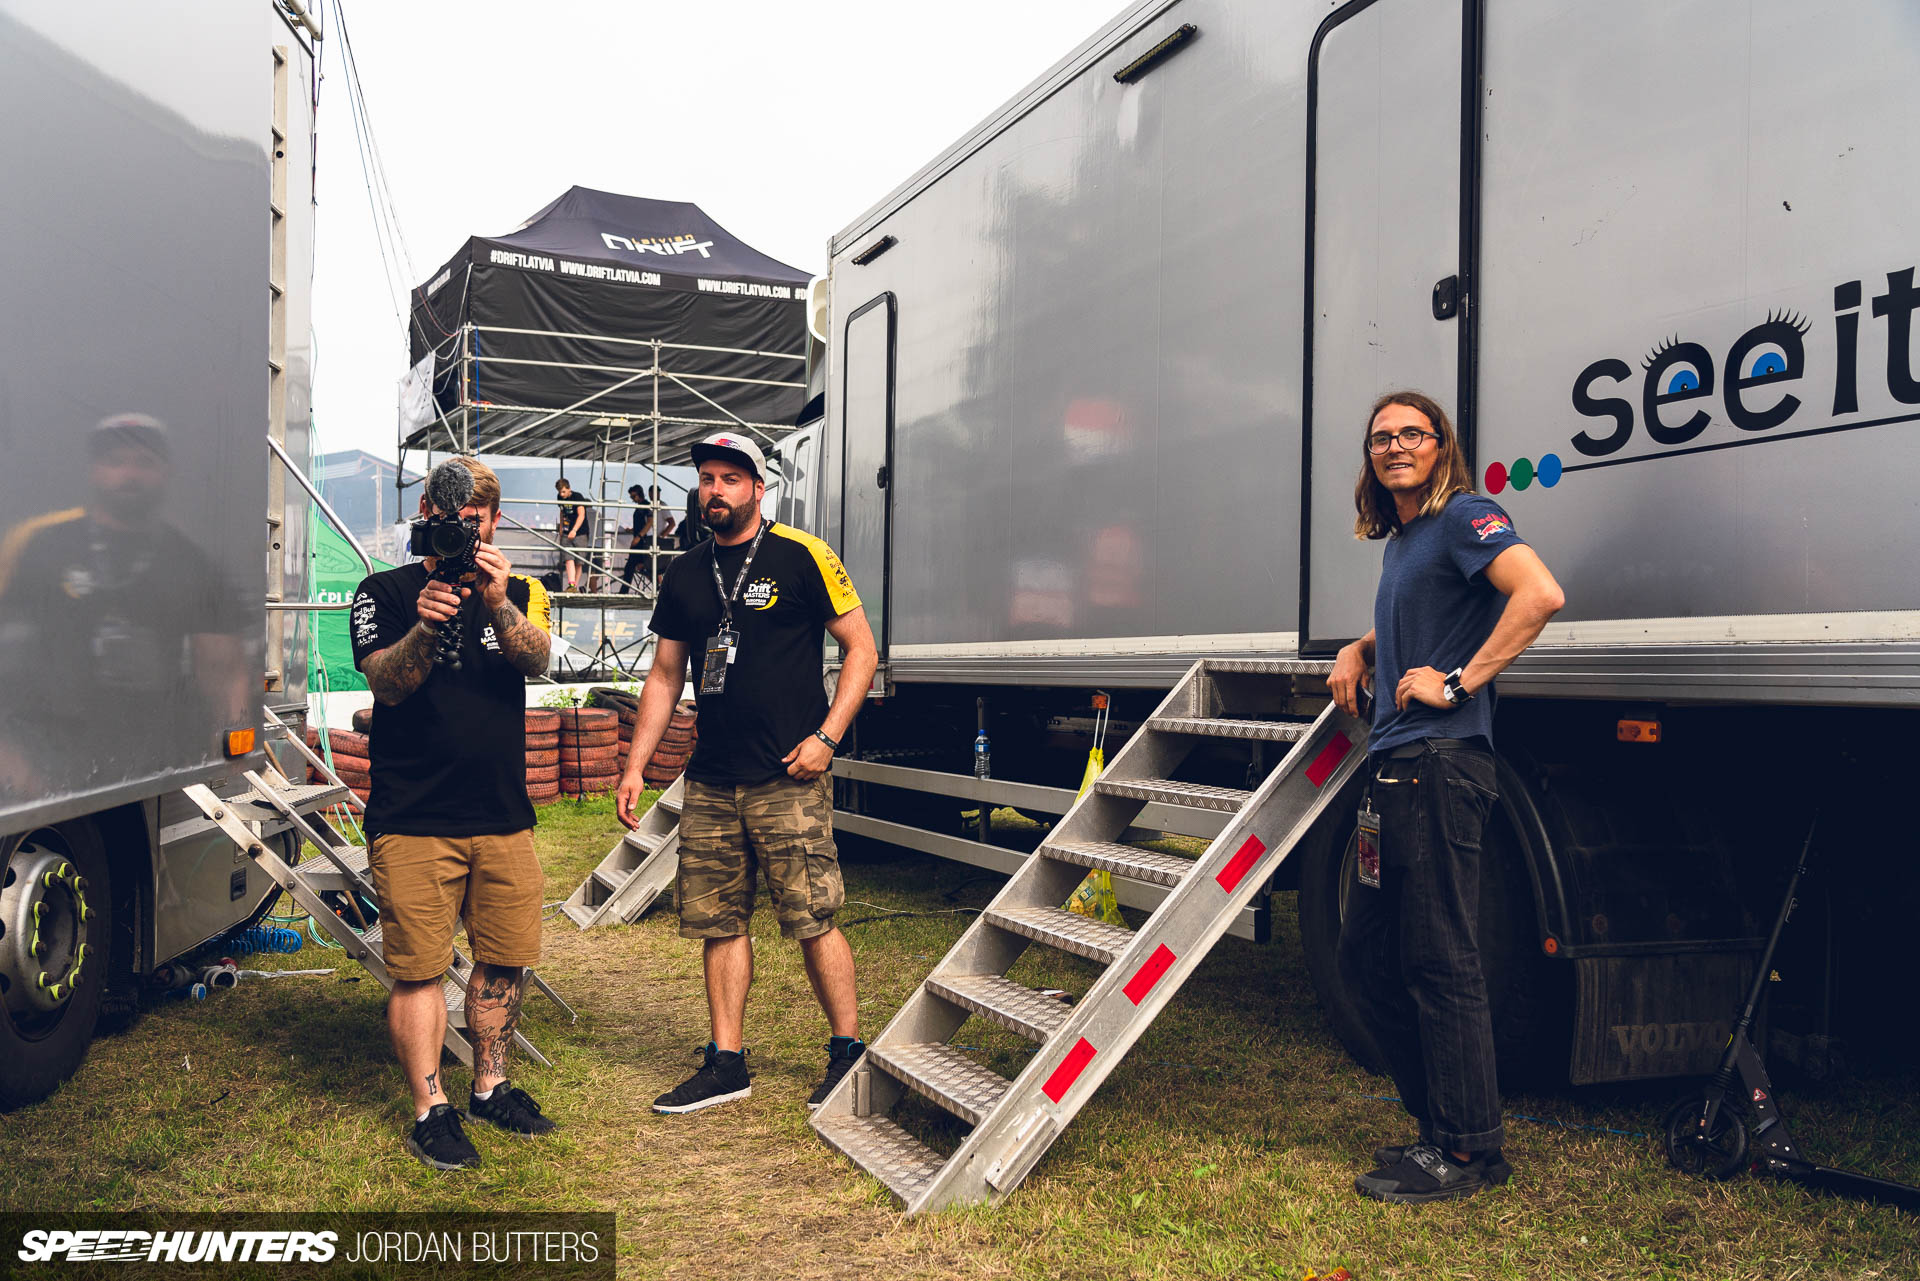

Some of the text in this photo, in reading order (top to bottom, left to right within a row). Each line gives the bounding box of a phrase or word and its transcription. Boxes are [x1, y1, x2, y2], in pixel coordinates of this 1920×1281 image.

[600, 232, 714, 259] DRIFT
[490, 249, 555, 272] #DRIFTLATVIA
[559, 260, 661, 286] WWW.DRIFTLATVIA.COM
[697, 278, 791, 300] WWW.DRIFTLATVIA.COM
[1471, 513, 1494, 529] Red
[748, 582, 771, 594] Drift
[1611, 1022, 1729, 1056] VOLVO
